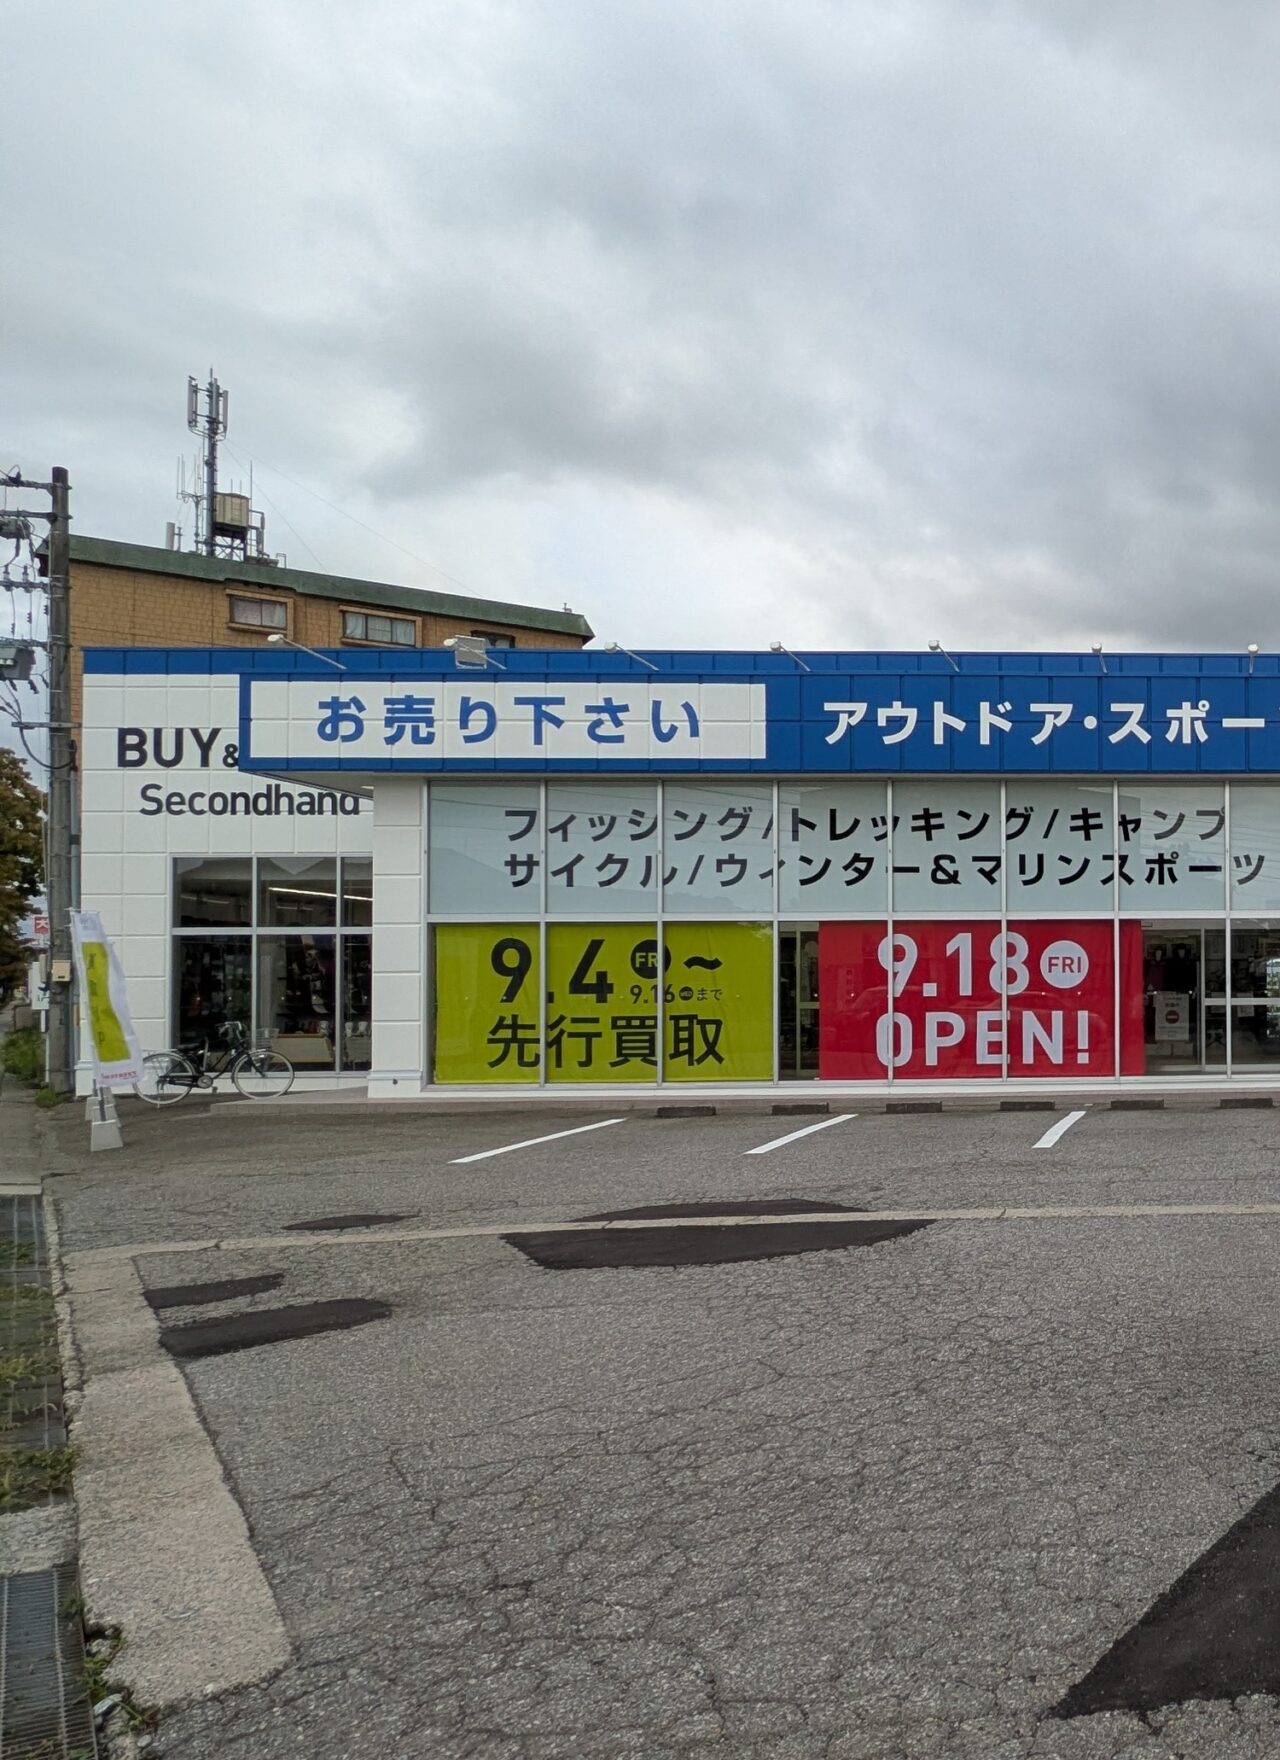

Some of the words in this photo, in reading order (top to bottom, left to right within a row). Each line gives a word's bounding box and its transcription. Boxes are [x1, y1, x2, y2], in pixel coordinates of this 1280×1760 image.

[317, 695, 700, 745] お売り下さい
[139, 783, 360, 816] Secondhand
[635, 952, 663, 968] FR
[877, 931, 1030, 998] 9.18
[1047, 956, 1082, 974] FRI
[486, 1013, 725, 1069] 先行買取
[875, 1010, 1090, 1067] OPEN!
